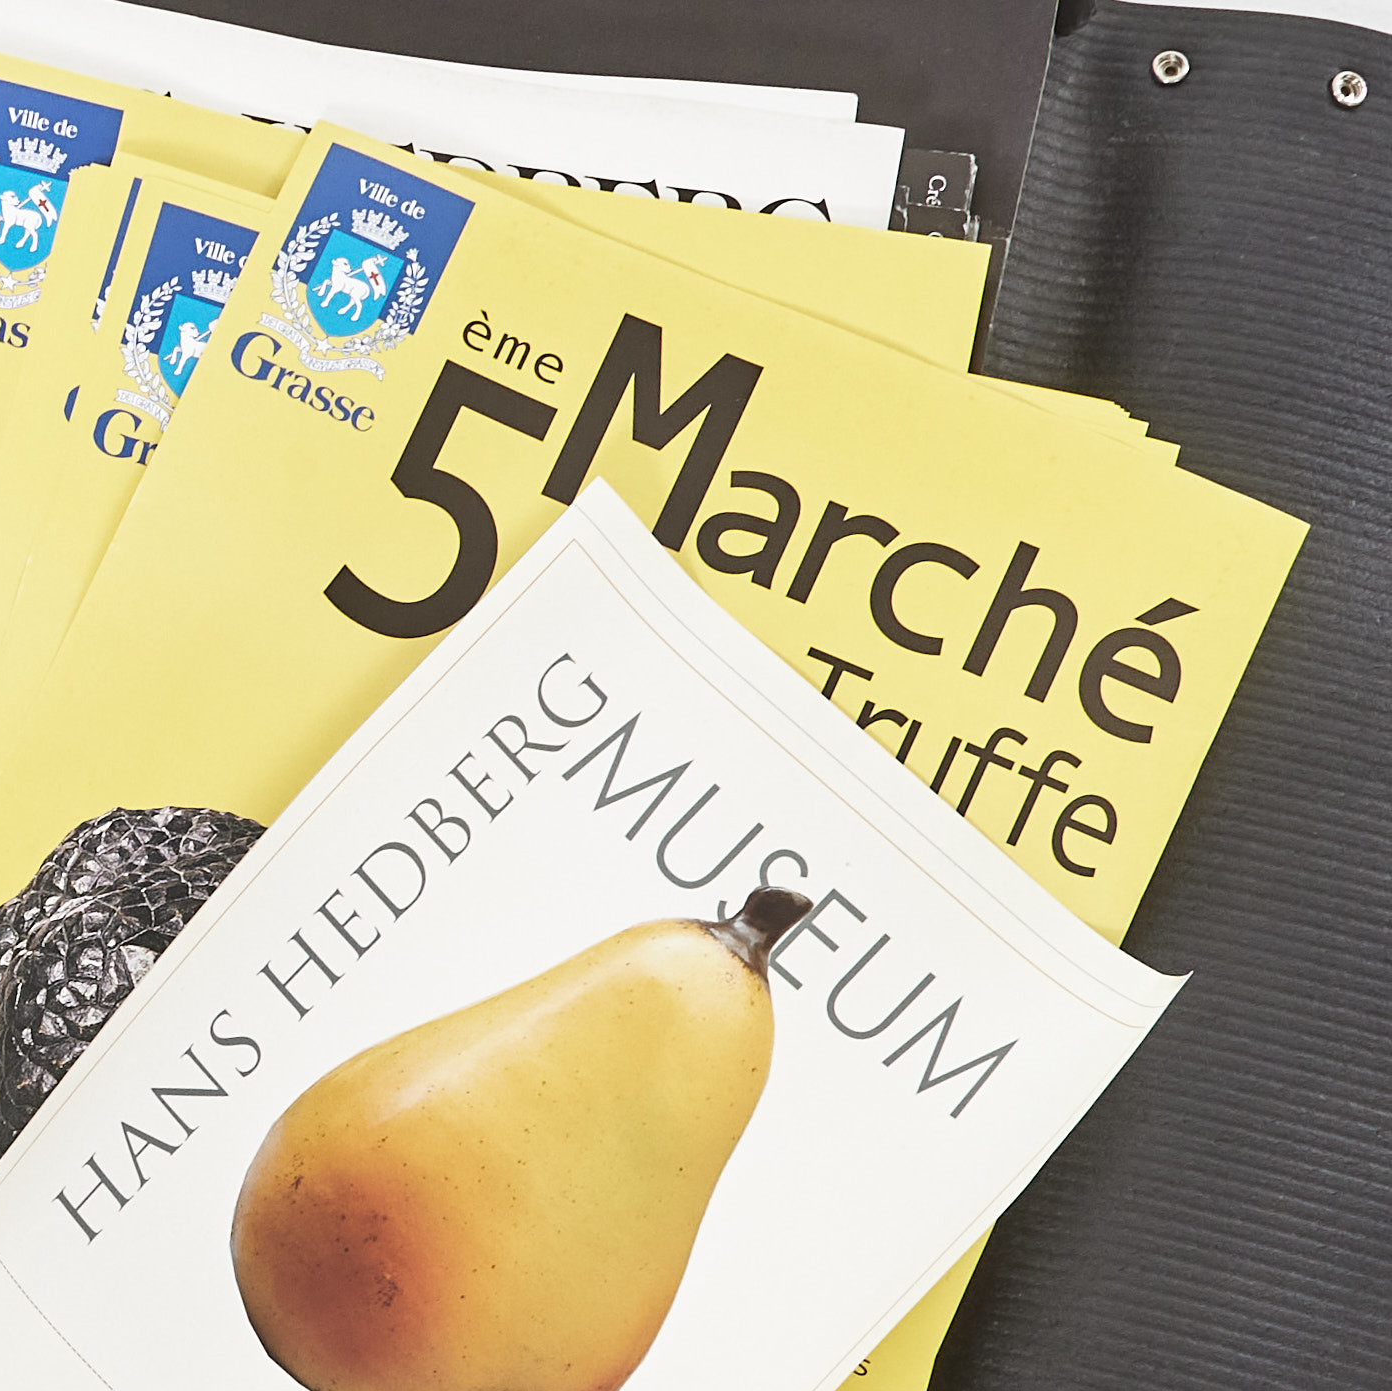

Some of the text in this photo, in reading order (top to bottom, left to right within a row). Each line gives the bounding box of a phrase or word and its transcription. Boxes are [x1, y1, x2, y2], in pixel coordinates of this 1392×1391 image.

[7, 106, 78, 140] Ville de
[358, 176, 425, 220] Ville de
[194, 236, 236, 265] Ville
[231, 331, 375, 432] Grasse
[460, 309, 565, 386] ème
[324, 313, 1200, 744] 5 Marché
[51, 652, 1020, 1246] HANS HEDBERG MUSEUM
